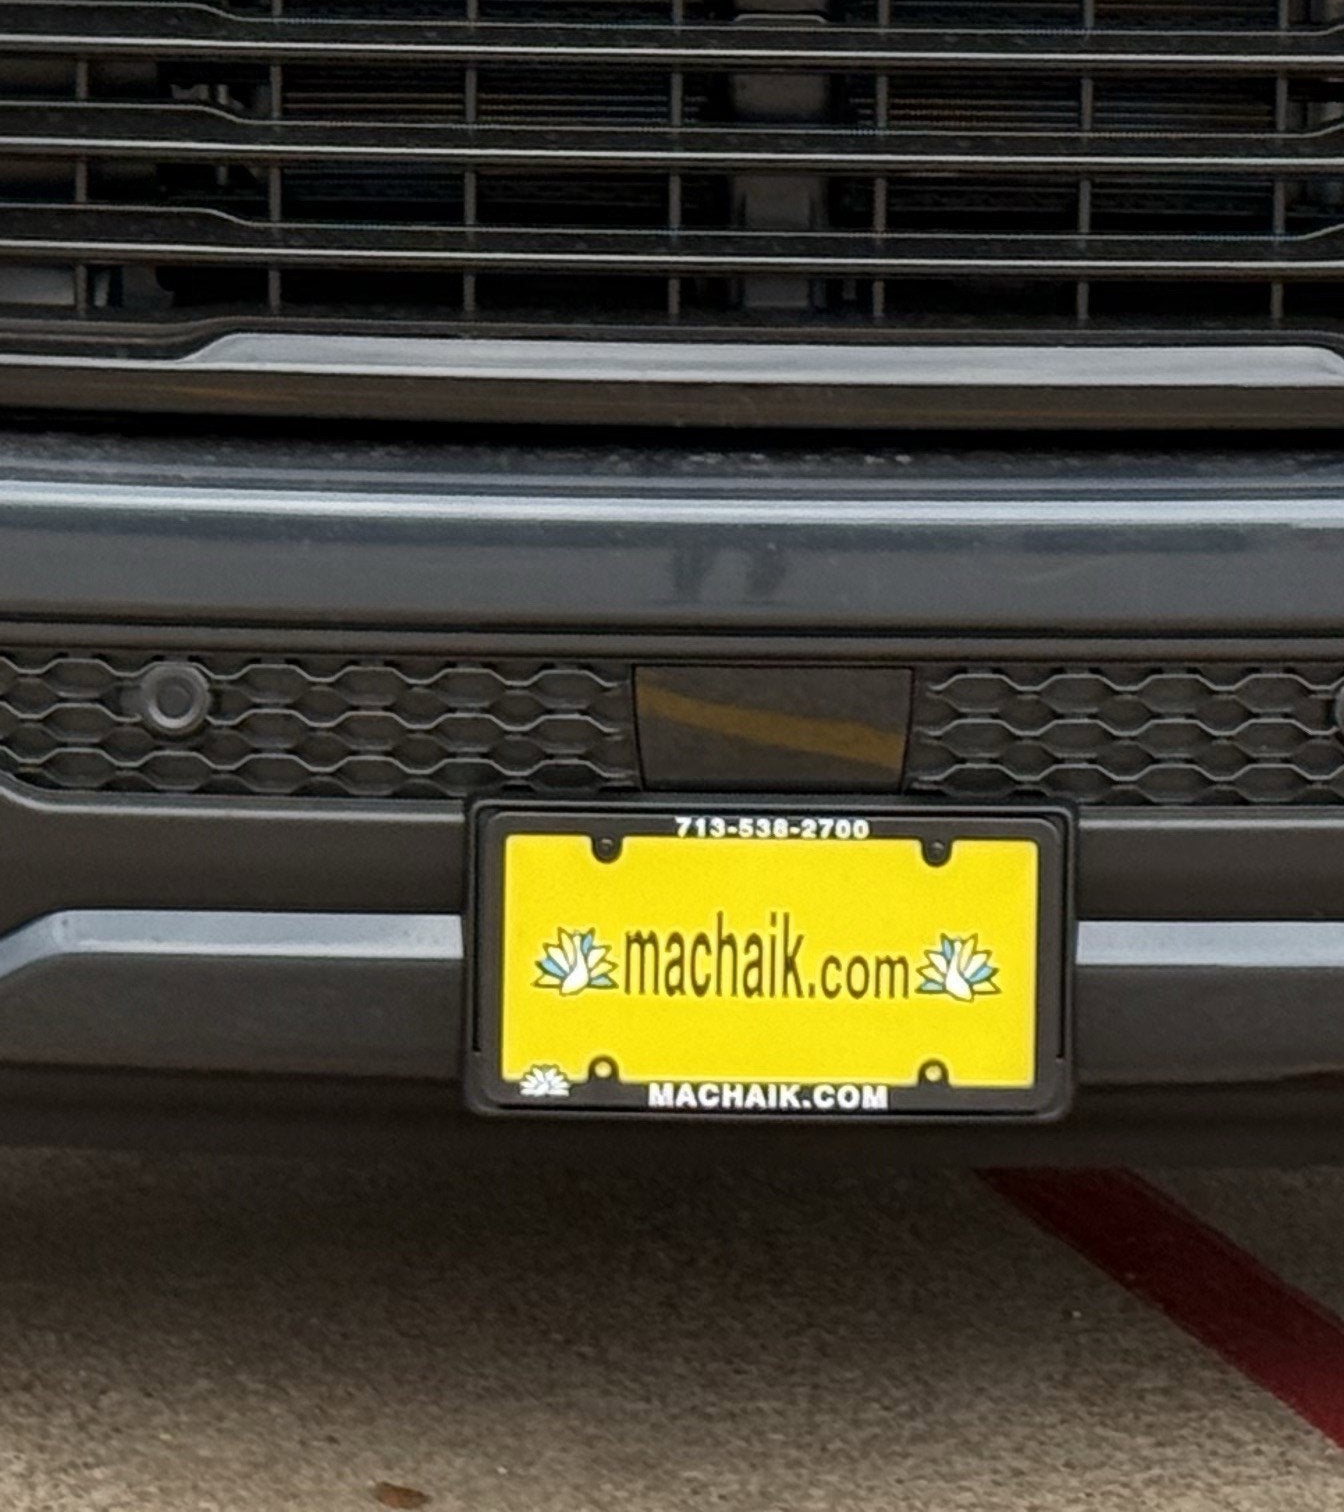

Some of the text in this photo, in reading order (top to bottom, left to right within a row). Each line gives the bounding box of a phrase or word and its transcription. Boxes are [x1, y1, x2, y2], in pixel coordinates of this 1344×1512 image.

[675, 817, 870, 839] 713-538-2700
[624, 911, 910, 999] machaik.com
[648, 1083, 889, 1109] MACHAIK.COM
